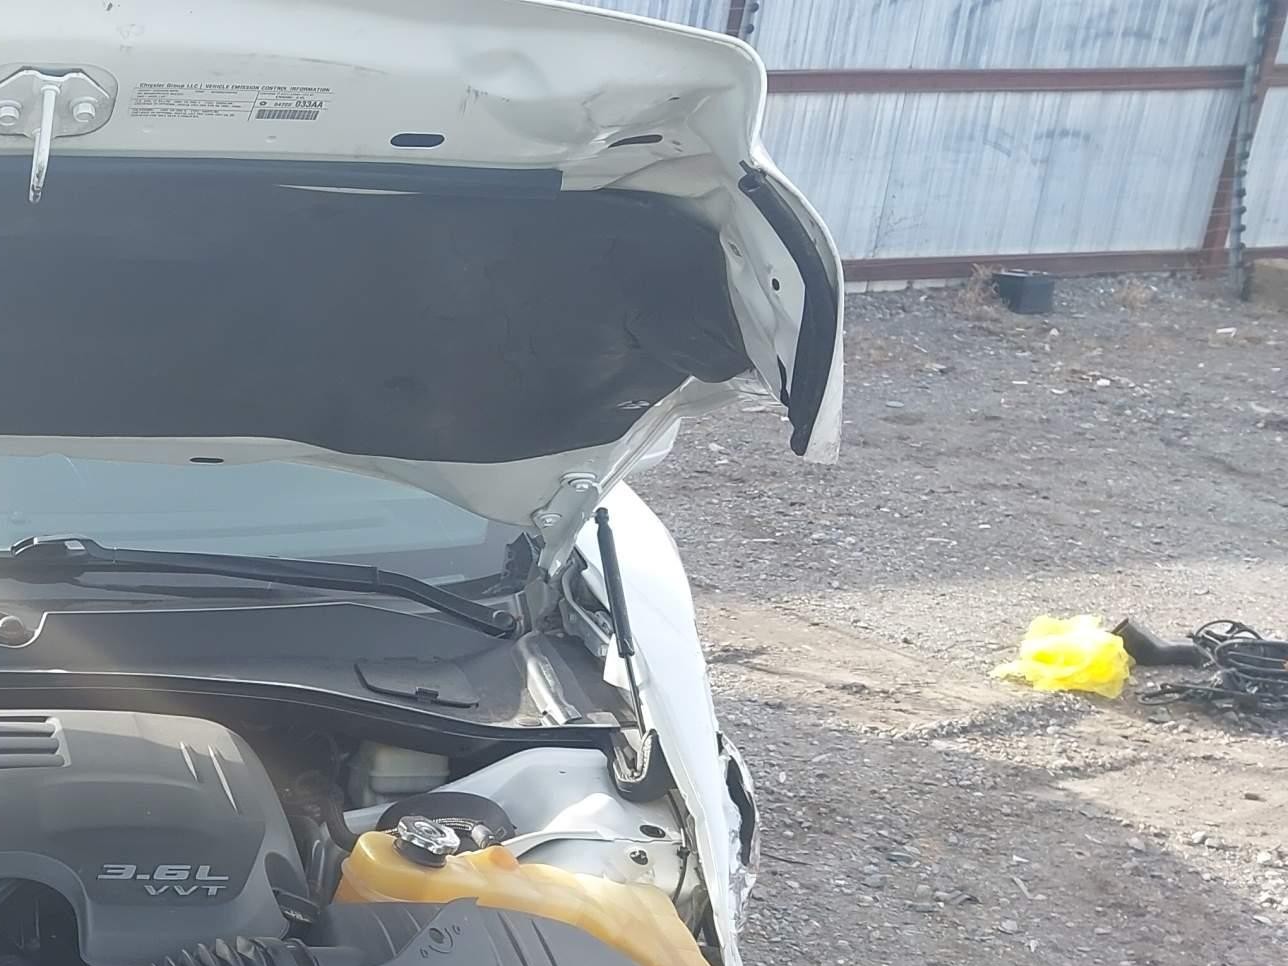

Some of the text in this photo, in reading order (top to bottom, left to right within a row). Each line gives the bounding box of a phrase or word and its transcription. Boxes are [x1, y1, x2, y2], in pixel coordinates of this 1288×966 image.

[295, 100, 323, 108] 033AA
[97, 864, 230, 880] 3.6L
[143, 884, 227, 896] VVT
